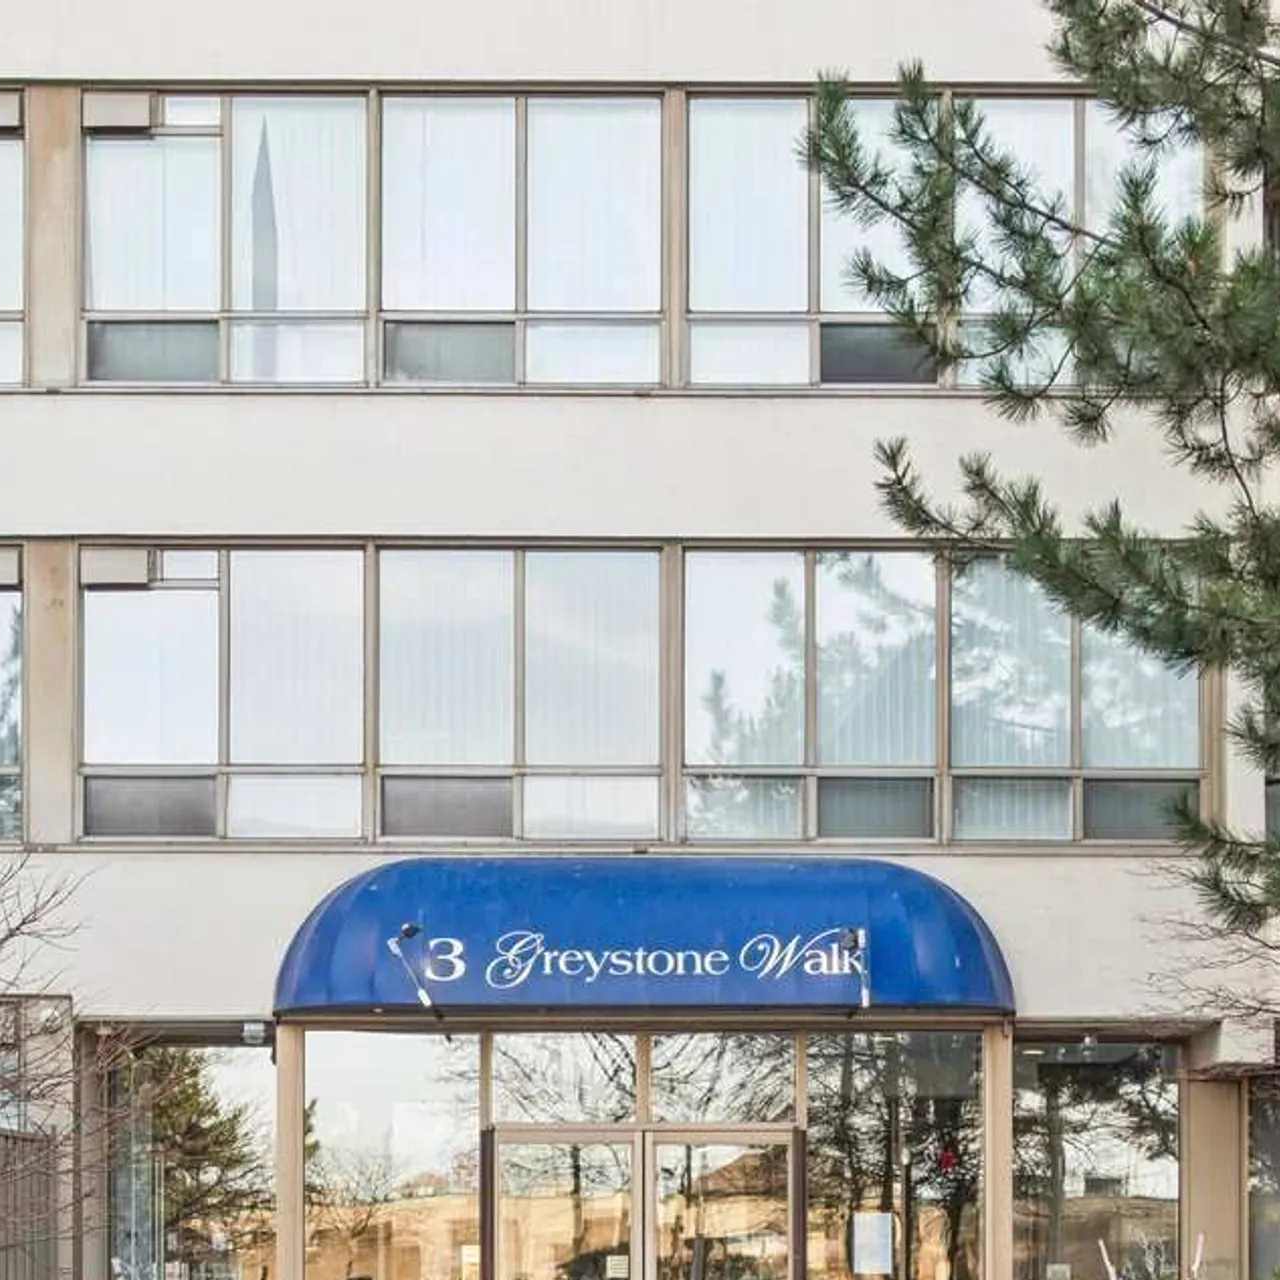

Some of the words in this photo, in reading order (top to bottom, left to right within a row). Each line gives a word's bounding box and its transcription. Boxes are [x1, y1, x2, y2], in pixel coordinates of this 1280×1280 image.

[425, 936, 466, 982] 3
[485, 930, 730, 989] Greystone
[739, 927, 867, 979] Walk
